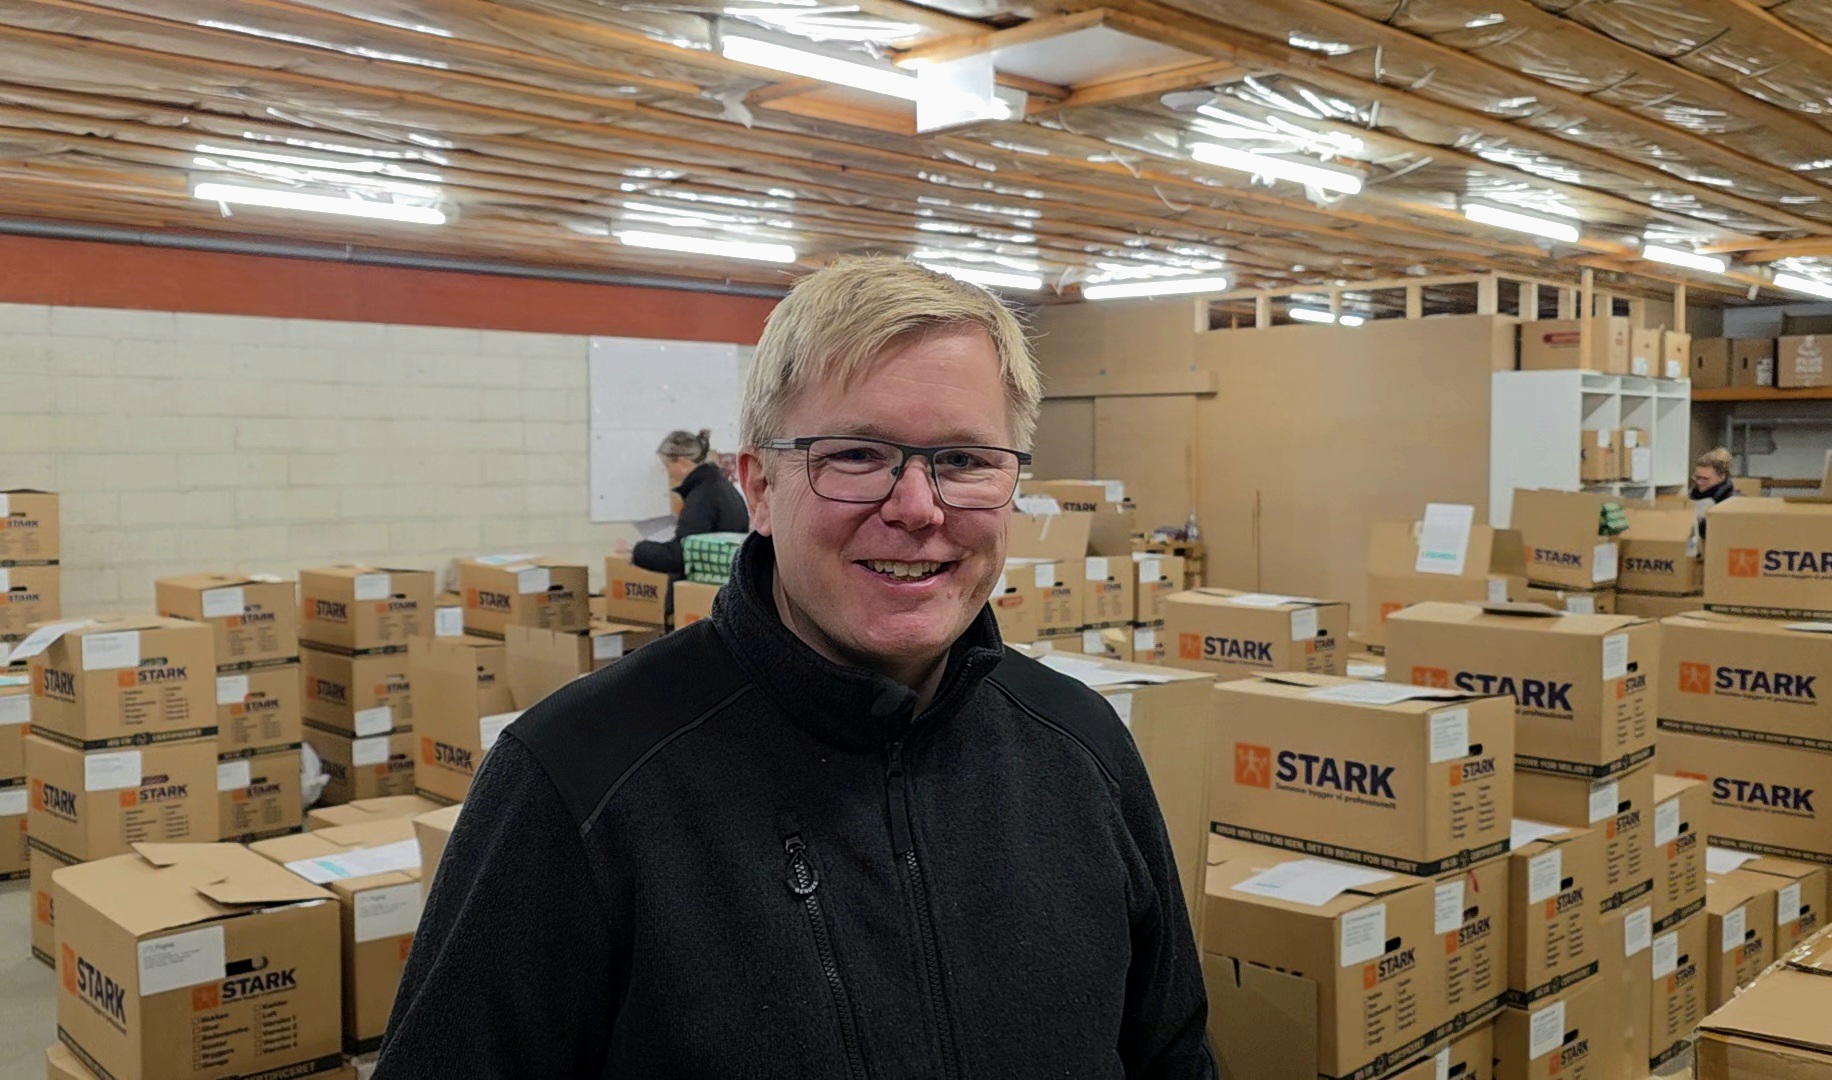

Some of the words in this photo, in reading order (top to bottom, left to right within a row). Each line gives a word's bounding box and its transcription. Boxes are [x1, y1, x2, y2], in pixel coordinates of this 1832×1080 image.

[1534, 549, 1582, 567] STARK
[1625, 558, 1674, 573] STARK
[1764, 549, 1832, 573] STAR
[479, 591, 511, 609] STARK
[625, 582, 658, 600] STARK
[315, 599, 347, 619] STARK
[387, 601, 417, 611] STARK
[240, 612, 275, 625] STARK
[1204, 636, 1273, 662] STARK
[1314, 638, 1336, 651] STARK
[44, 668, 76, 697] STARK
[138, 667, 187, 681] STARK
[1625, 674, 1646, 692] STARK
[1715, 666, 1816, 699] STARK
[316, 679, 346, 701] STARK
[1454, 671, 1574, 712] STARK
[244, 699, 279, 713] STARK
[435, 742, 474, 771] STARK
[1276, 750, 1395, 800] STARK
[1463, 757, 1496, 779] STARK
[43, 783, 77, 817] STARK
[139, 784, 188, 801] STARK
[1712, 777, 1815, 813] STARK
[1616, 810, 1640, 830] STARK
[1557, 887, 1584, 909] STARK
[1459, 917, 1491, 943] STARK
[1378, 948, 1416, 979] STARK
[77, 956, 126, 1026] STARK
[221, 968, 296, 1000] STARK
[1561, 1039, 1589, 1067] STARK
